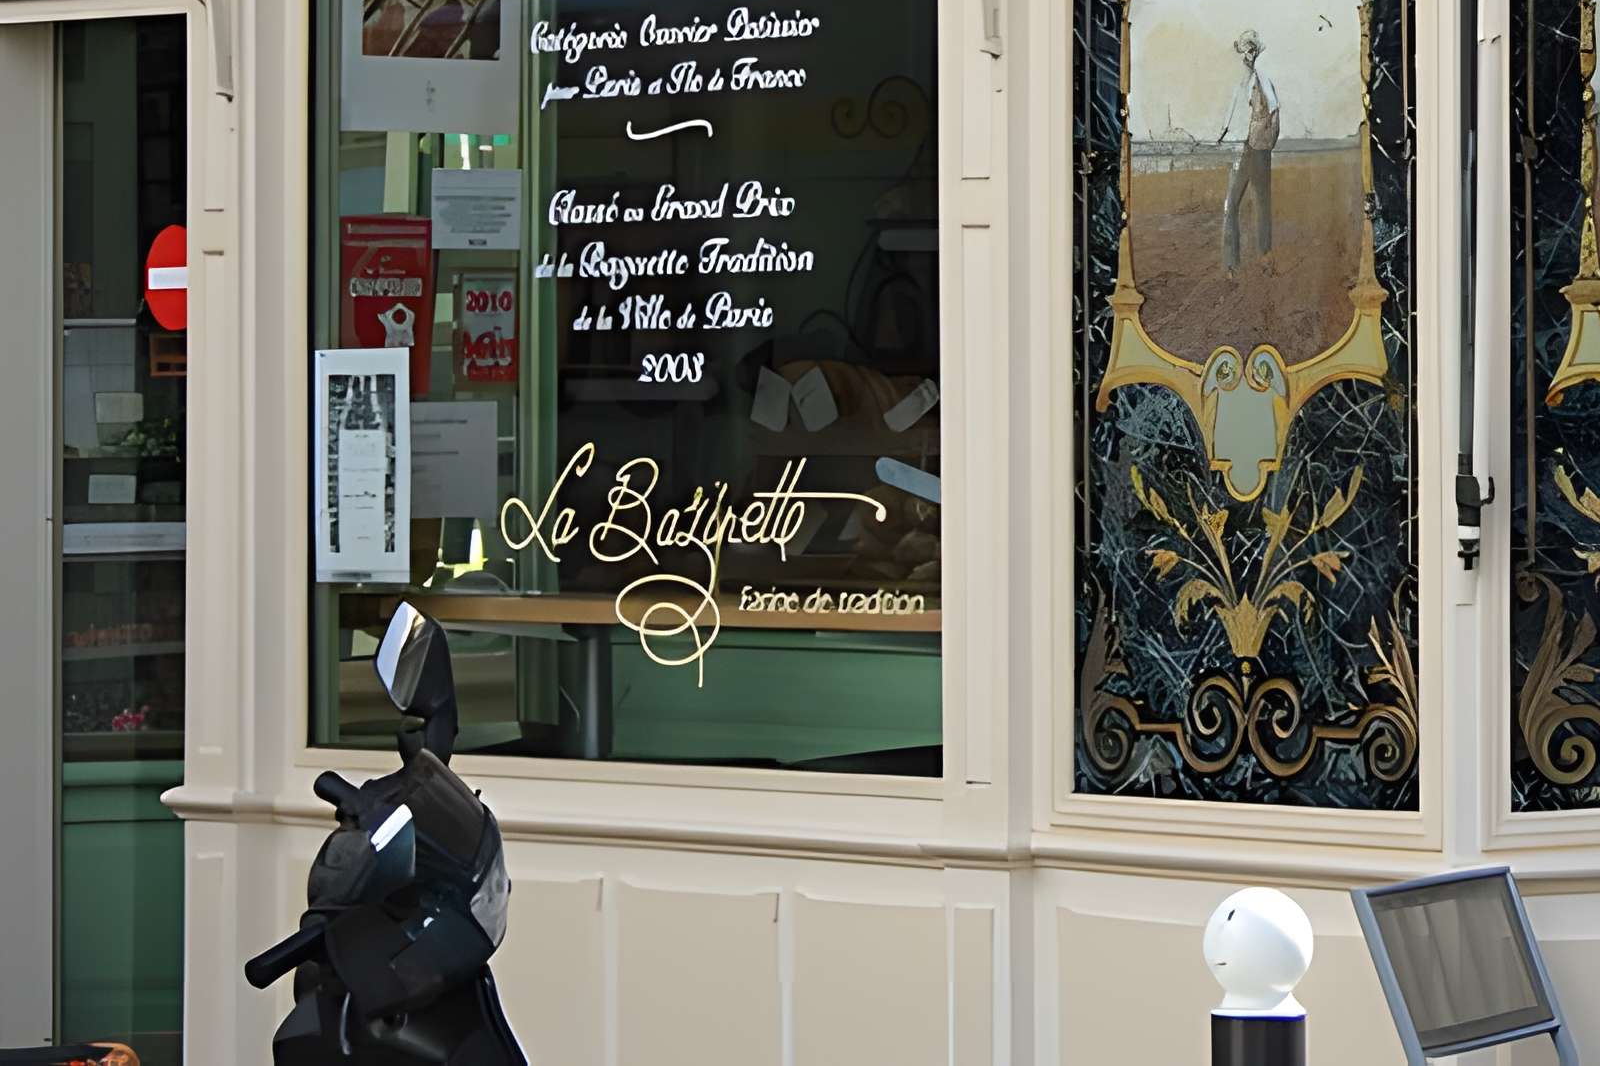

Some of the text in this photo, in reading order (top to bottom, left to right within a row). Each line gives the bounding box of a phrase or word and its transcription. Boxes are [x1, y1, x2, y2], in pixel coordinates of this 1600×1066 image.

[733, 181, 795, 218] Prix
[580, 241, 688, 290] Baguette
[699, 237, 814, 274] Tradition
